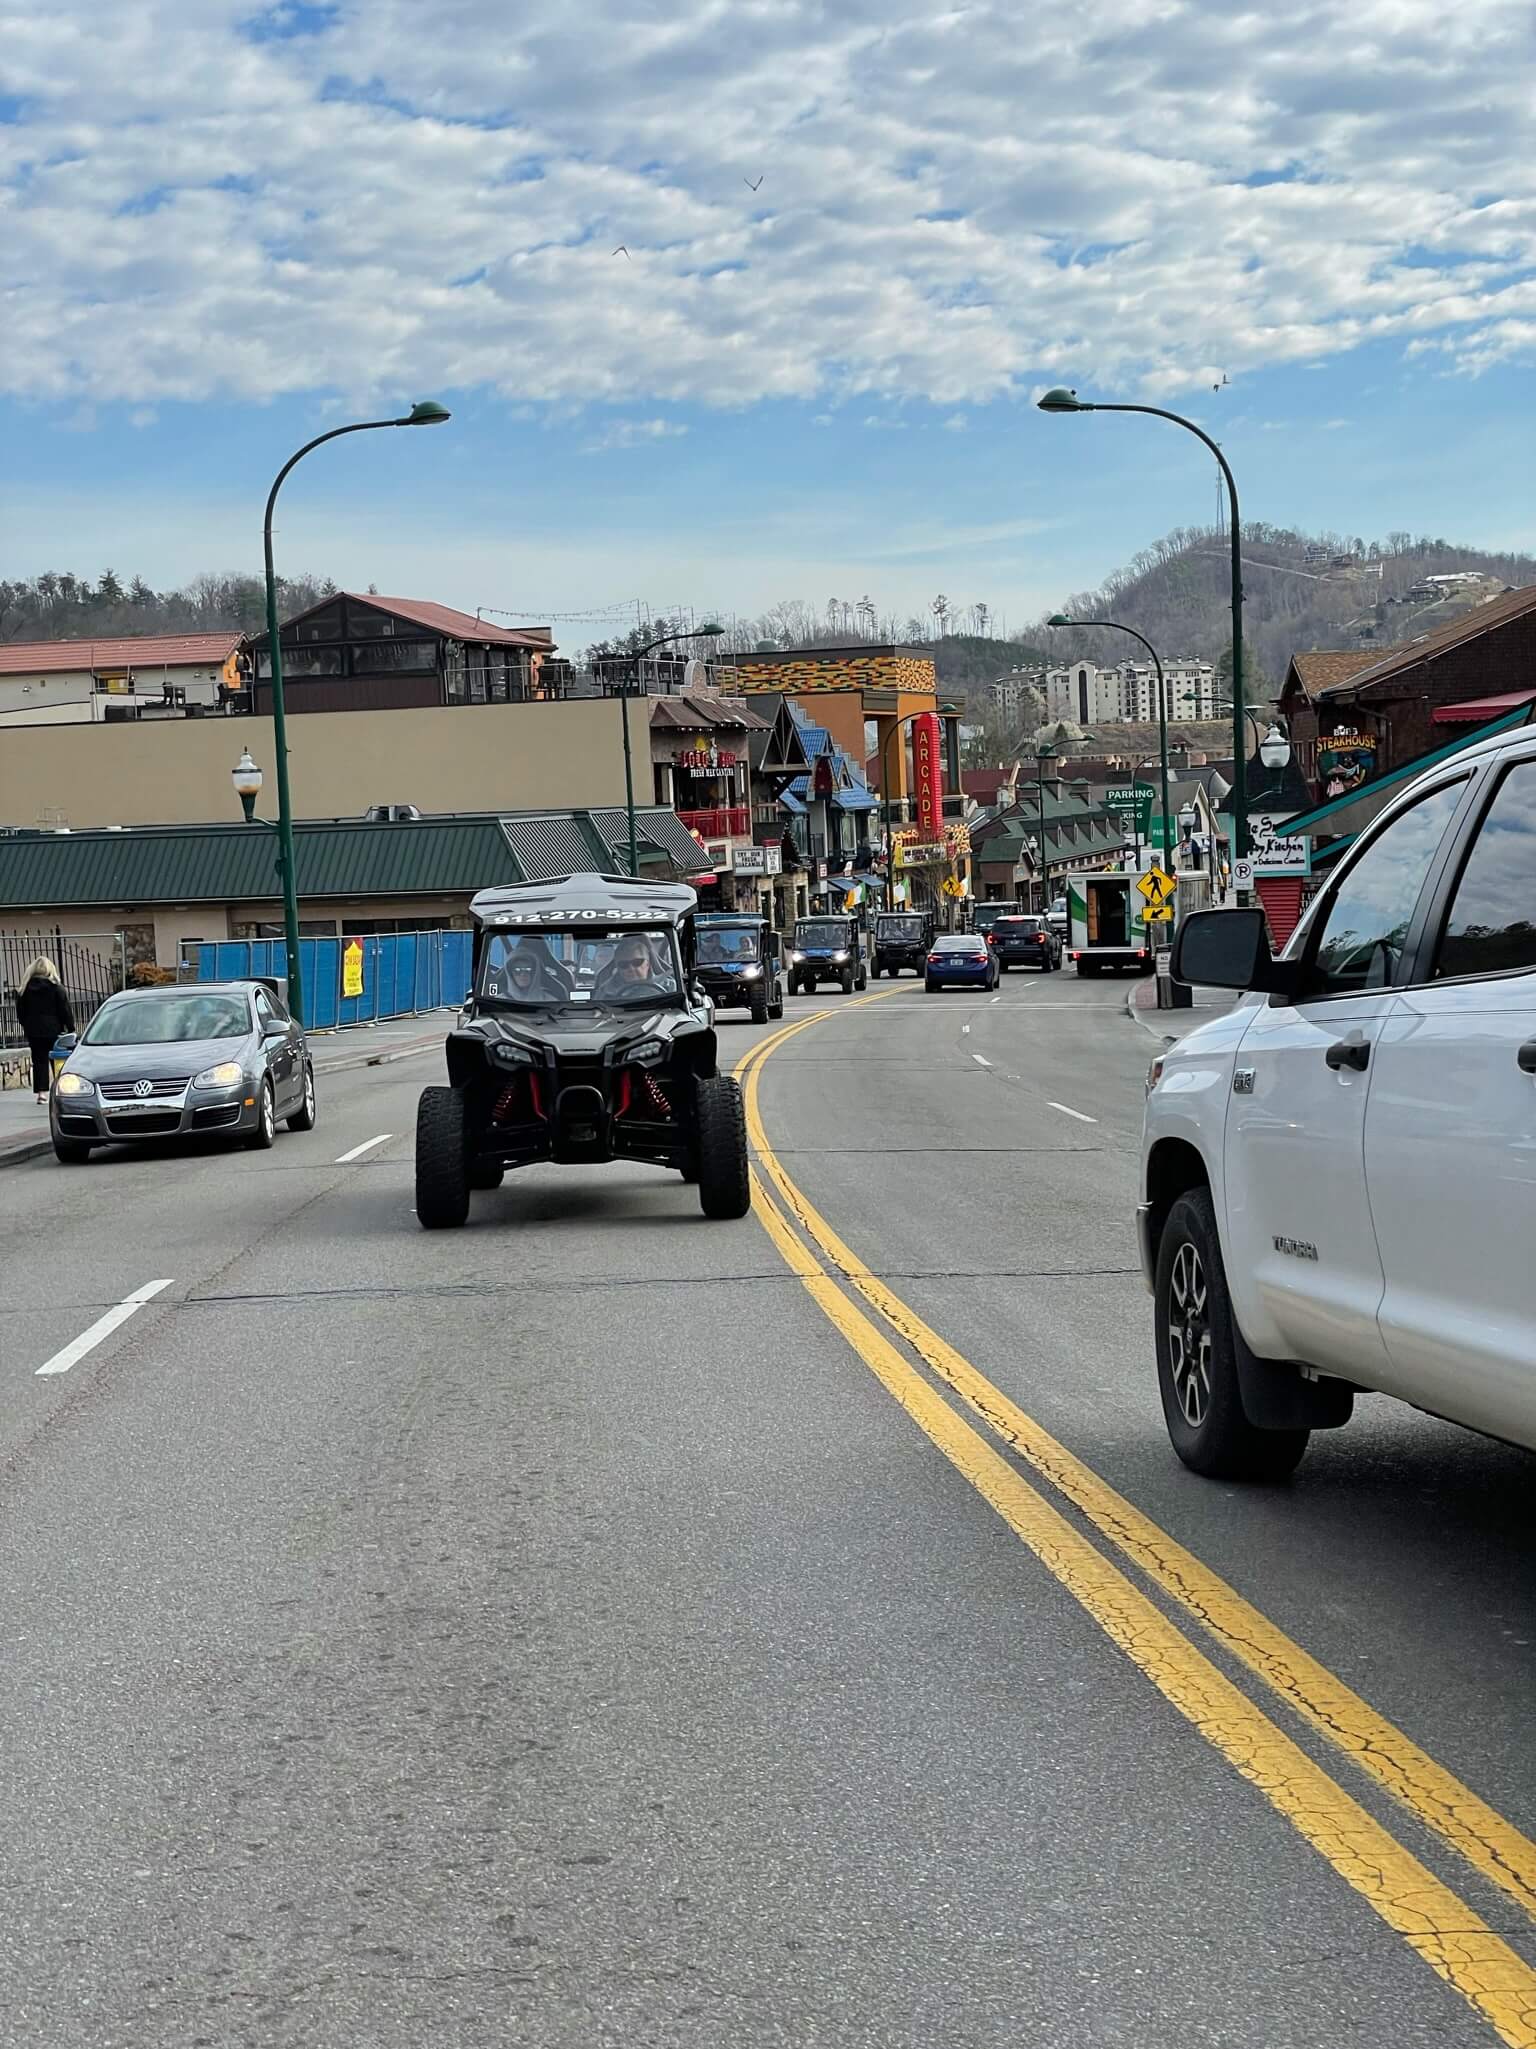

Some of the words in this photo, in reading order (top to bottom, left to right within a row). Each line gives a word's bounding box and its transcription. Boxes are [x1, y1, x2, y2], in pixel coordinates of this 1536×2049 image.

[1316, 734, 1377, 753] STEAKHOUSE
[919, 731, 931, 829] ARCADE
[1108, 789, 1154, 800] PARKING
[1265, 838, 1303, 856] Kitchen
[494, 910, 669, 924] 912-270-5222
[489, 984, 497, 995] 6
[1272, 1235, 1319, 1261] TUNDRA
